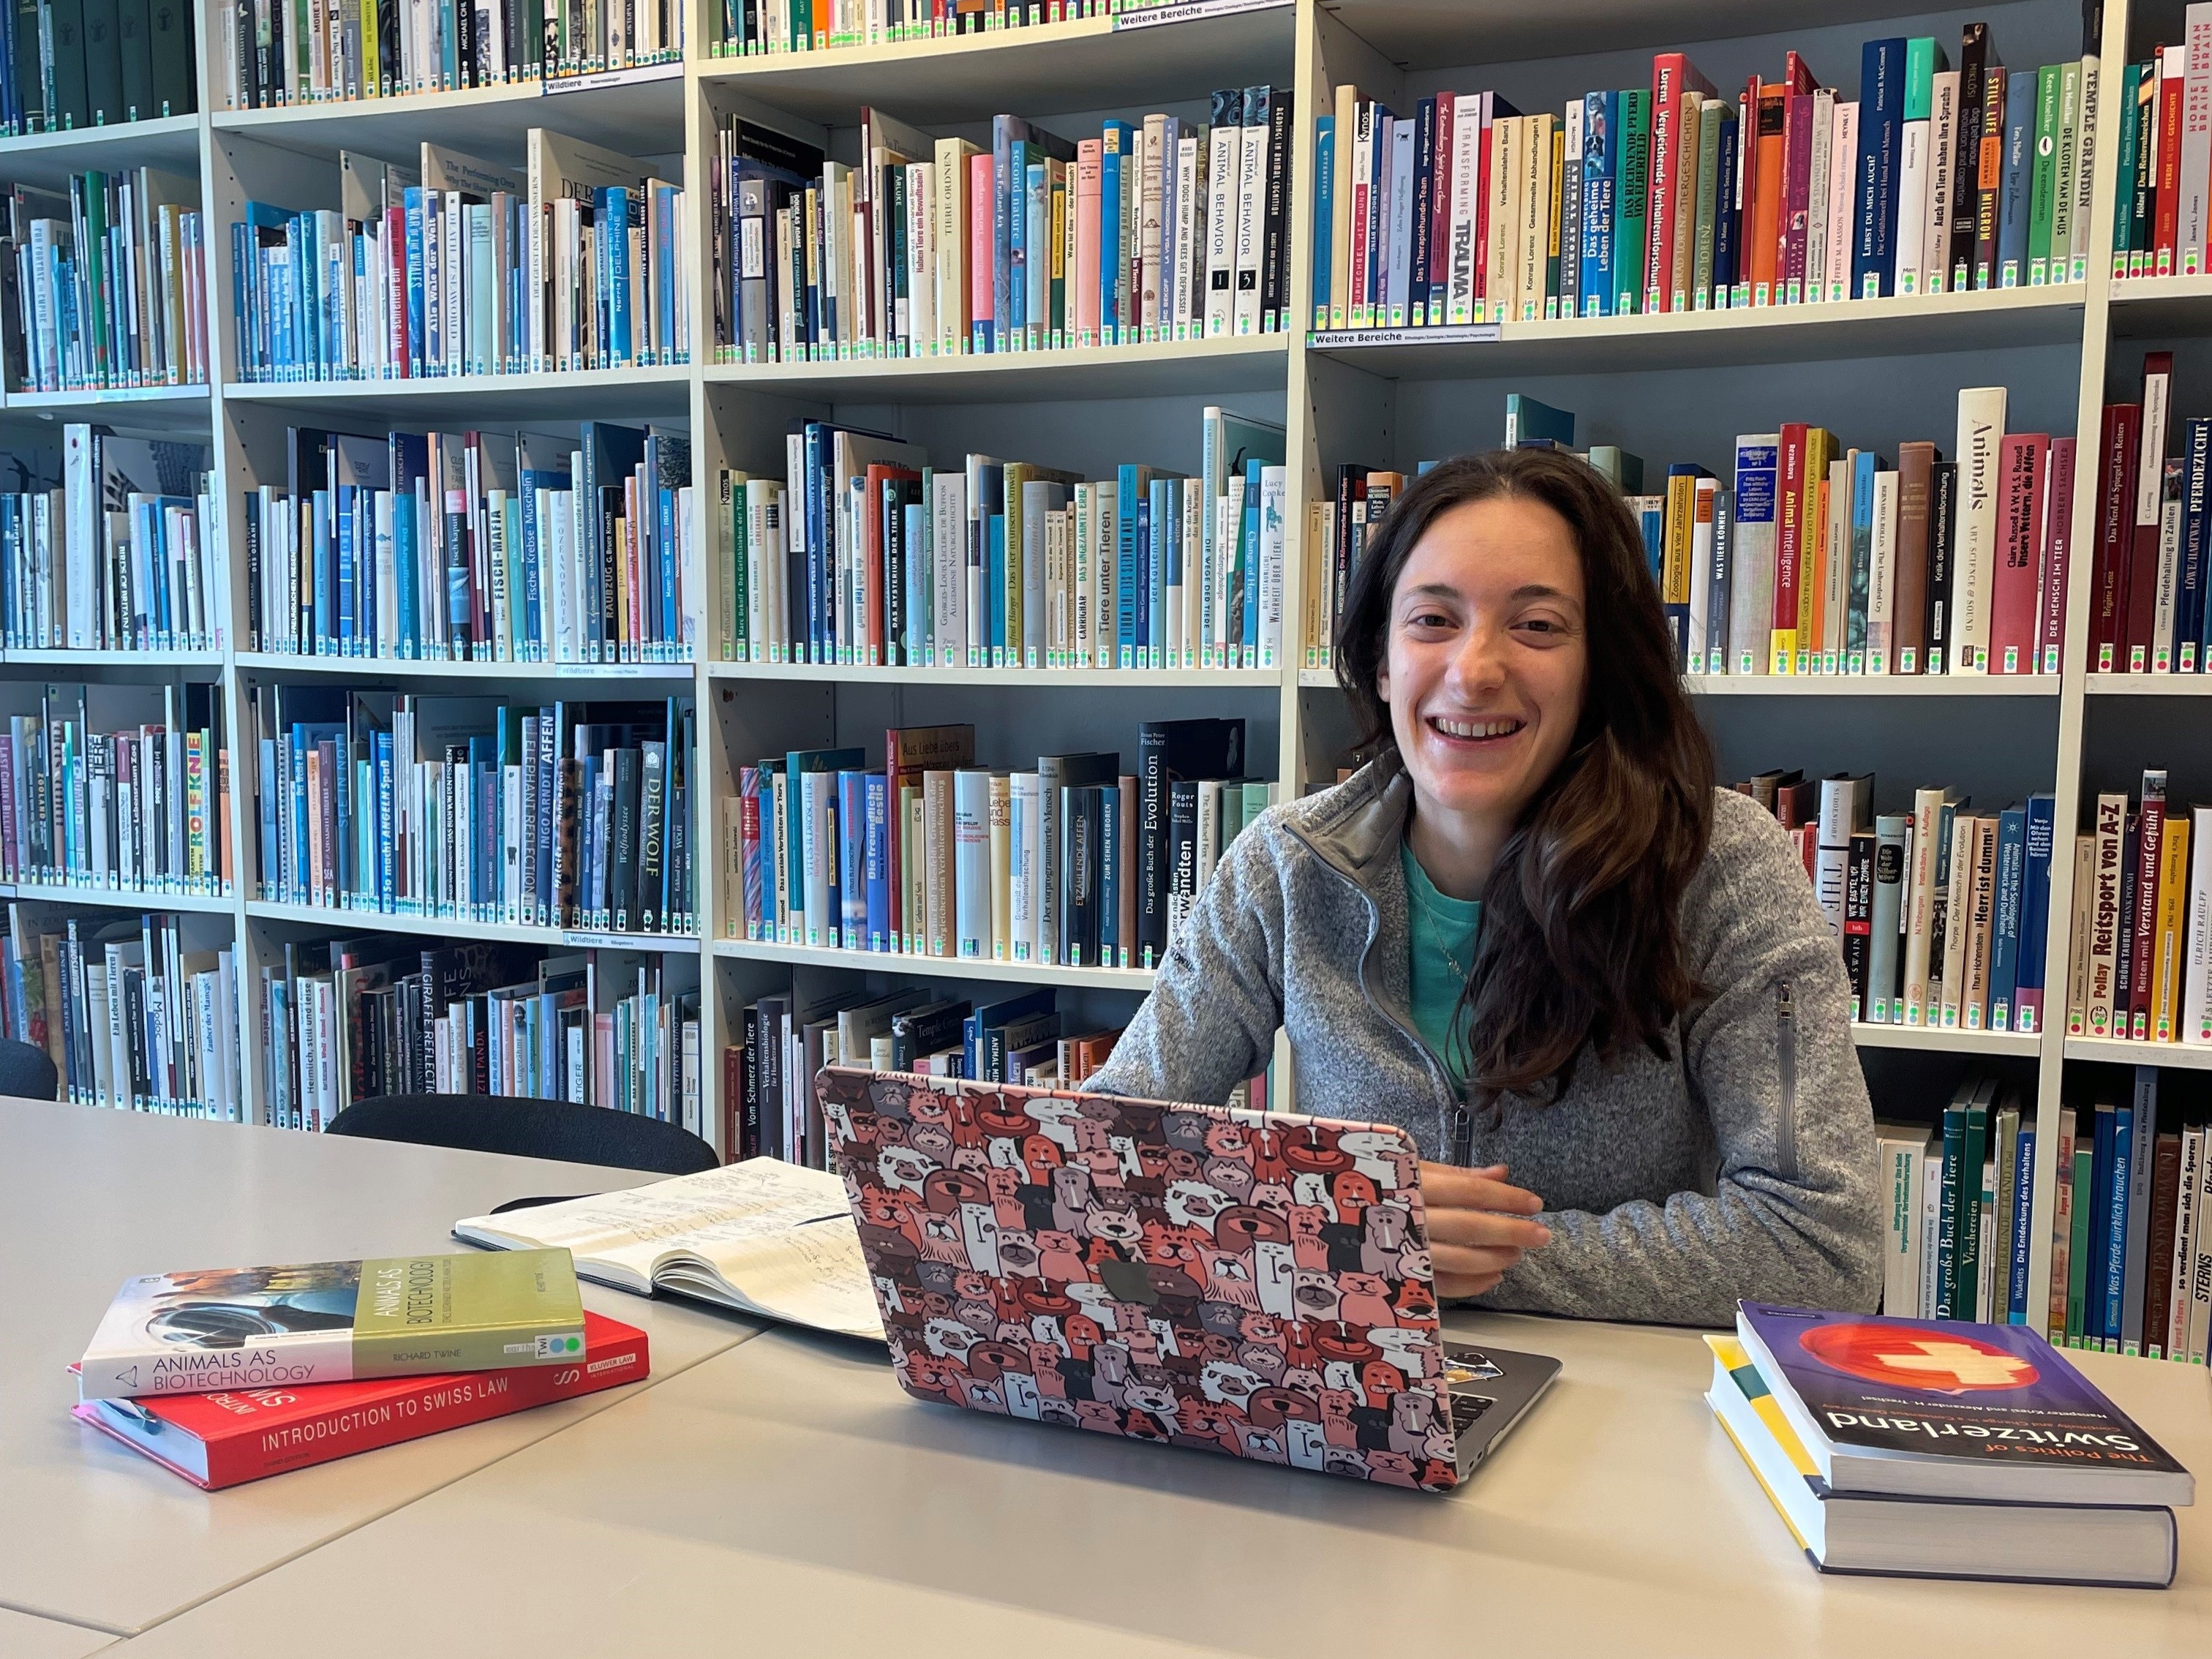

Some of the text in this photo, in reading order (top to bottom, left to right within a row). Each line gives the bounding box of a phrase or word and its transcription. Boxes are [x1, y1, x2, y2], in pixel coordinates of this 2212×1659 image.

[1121, 7, 1202, 25] Weitere Bereiche
[548, 79, 582, 90] Wildtiere
[2189, 24, 2201, 132] HORSE HUMAN
[2199, 24, 2211, 131] BRAIN BRAIN
[1939, 86, 1951, 119] Sprache
[1985, 78, 1999, 133] STILL LIFE
[1357, 112, 1369, 143] Kynos
[2080, 70, 2098, 207] TEMPLE GRANDIN
[1459, 126, 1472, 216] TRANSFORMING
[1867, 155, 1876, 183] AUCH?
[1939, 139, 1947, 163] haben
[1647, 68, 1671, 295] Lorenz Vergleichende Verhaltensforschung
[1938, 164, 1946, 186] Tiere
[2057, 128, 2072, 236] DE KLOTEN VAN DE MUS
[1214, 141, 1226, 256] ANIMAL BEHAVIOR
[1241, 140, 1254, 255] ANIMAL BEHAVIOR
[1865, 209, 1873, 223] DU
[1979, 193, 1993, 240] MILGROM
[1568, 165, 1579, 285] ANIMAL STORIES
[1587, 181, 1599, 257] Das geheime
[1598, 181, 1611, 271] Leben der Tiere
[1453, 220, 1471, 300] TRAUMA
[1862, 225, 1871, 256] LIEBST
[1316, 334, 1354, 344] Weitere
[1358, 333, 1402, 342] Bereiche
[1265, 480, 1283, 488] Lucy
[1969, 420, 1993, 511] Animals
[2190, 425, 2208, 512] PFERDEZUCHT
[492, 509, 504, 600] FISCH-MAFIA
[524, 477, 537, 601] Fische Krebse Muscheln
[1781, 490, 1796, 588] Animal Intelligence
[1099, 511, 1110, 635] Tiere unter Tieren
[1716, 560, 1724, 579] WAS
[2050, 539, 2063, 637] DER MENSCH IM TIER
[189, 737, 203, 846] ROLF KNIE
[541, 716, 553, 849] INGO ARNDT AFFEN
[1145, 755, 1157, 830] Evolution
[1172, 792, 1195, 800] Roger
[645, 778, 661, 877] DER WOLF
[1147, 873, 1155, 895] große
[1822, 864, 1843, 911] THE
[2093, 803, 2120, 998] Pollay Reitsport von A-Z
[2137, 810, 2158, 993] Reiten mit Verstand und Gefühl
[152, 1001, 162, 1038] Modoc
[421, 974, 432, 1026] GIRAFFE
[747, 1064, 756, 1103] Schmerz
[1943, 1154, 1957, 1192] Tiere
[2021, 1143, 2031, 1190] Verhaltens
[2186, 1139, 2196, 1175] Sporen
[2183, 1196, 2192, 1214] sich
[1940, 1216, 1955, 1249] Buch
[1963, 1200, 1978, 1266] Viechereien
[2018, 1206, 2028, 1246] Entdeckung
[2108, 1157, 2126, 1295] Was Pferde wirklich brauchen
[2181, 1216, 2190, 1237] man
[1943, 1252, 1956, 1289] große
[2179, 1240, 2189, 1276] verdient
[2196, 1254, 2211, 1302] STERNS
[374, 1268, 403, 1317] ANIMALS AS
[407, 1260, 434, 1324] BIOTECHNOLOGY
[1938, 1290, 1950, 1318] Das
[2178, 1279, 2185, 1289] so
[153, 1350, 276, 1373] ANIMALS AS
[393, 1349, 462, 1361] RICHARD TWINE
[538, 1338, 548, 1356] Twi
[589, 1355, 633, 1371] KLUWER LAW
[154, 1364, 315, 1390] BIOTECHNOLOGY
[590, 1364, 634, 1378] INTERNATIONAL
[262, 1377, 508, 1452] INTRODUCTION TO SWISS LAW
[1861, 1396, 1909, 1405] Trechsel
[1927, 1402, 1983, 1411] Alexander
[2047, 1410, 2107, 1419] Hanspeter
[1827, 1412, 2140, 1451] Switzerland
[1985, 1444, 2154, 1462] The Politics of
